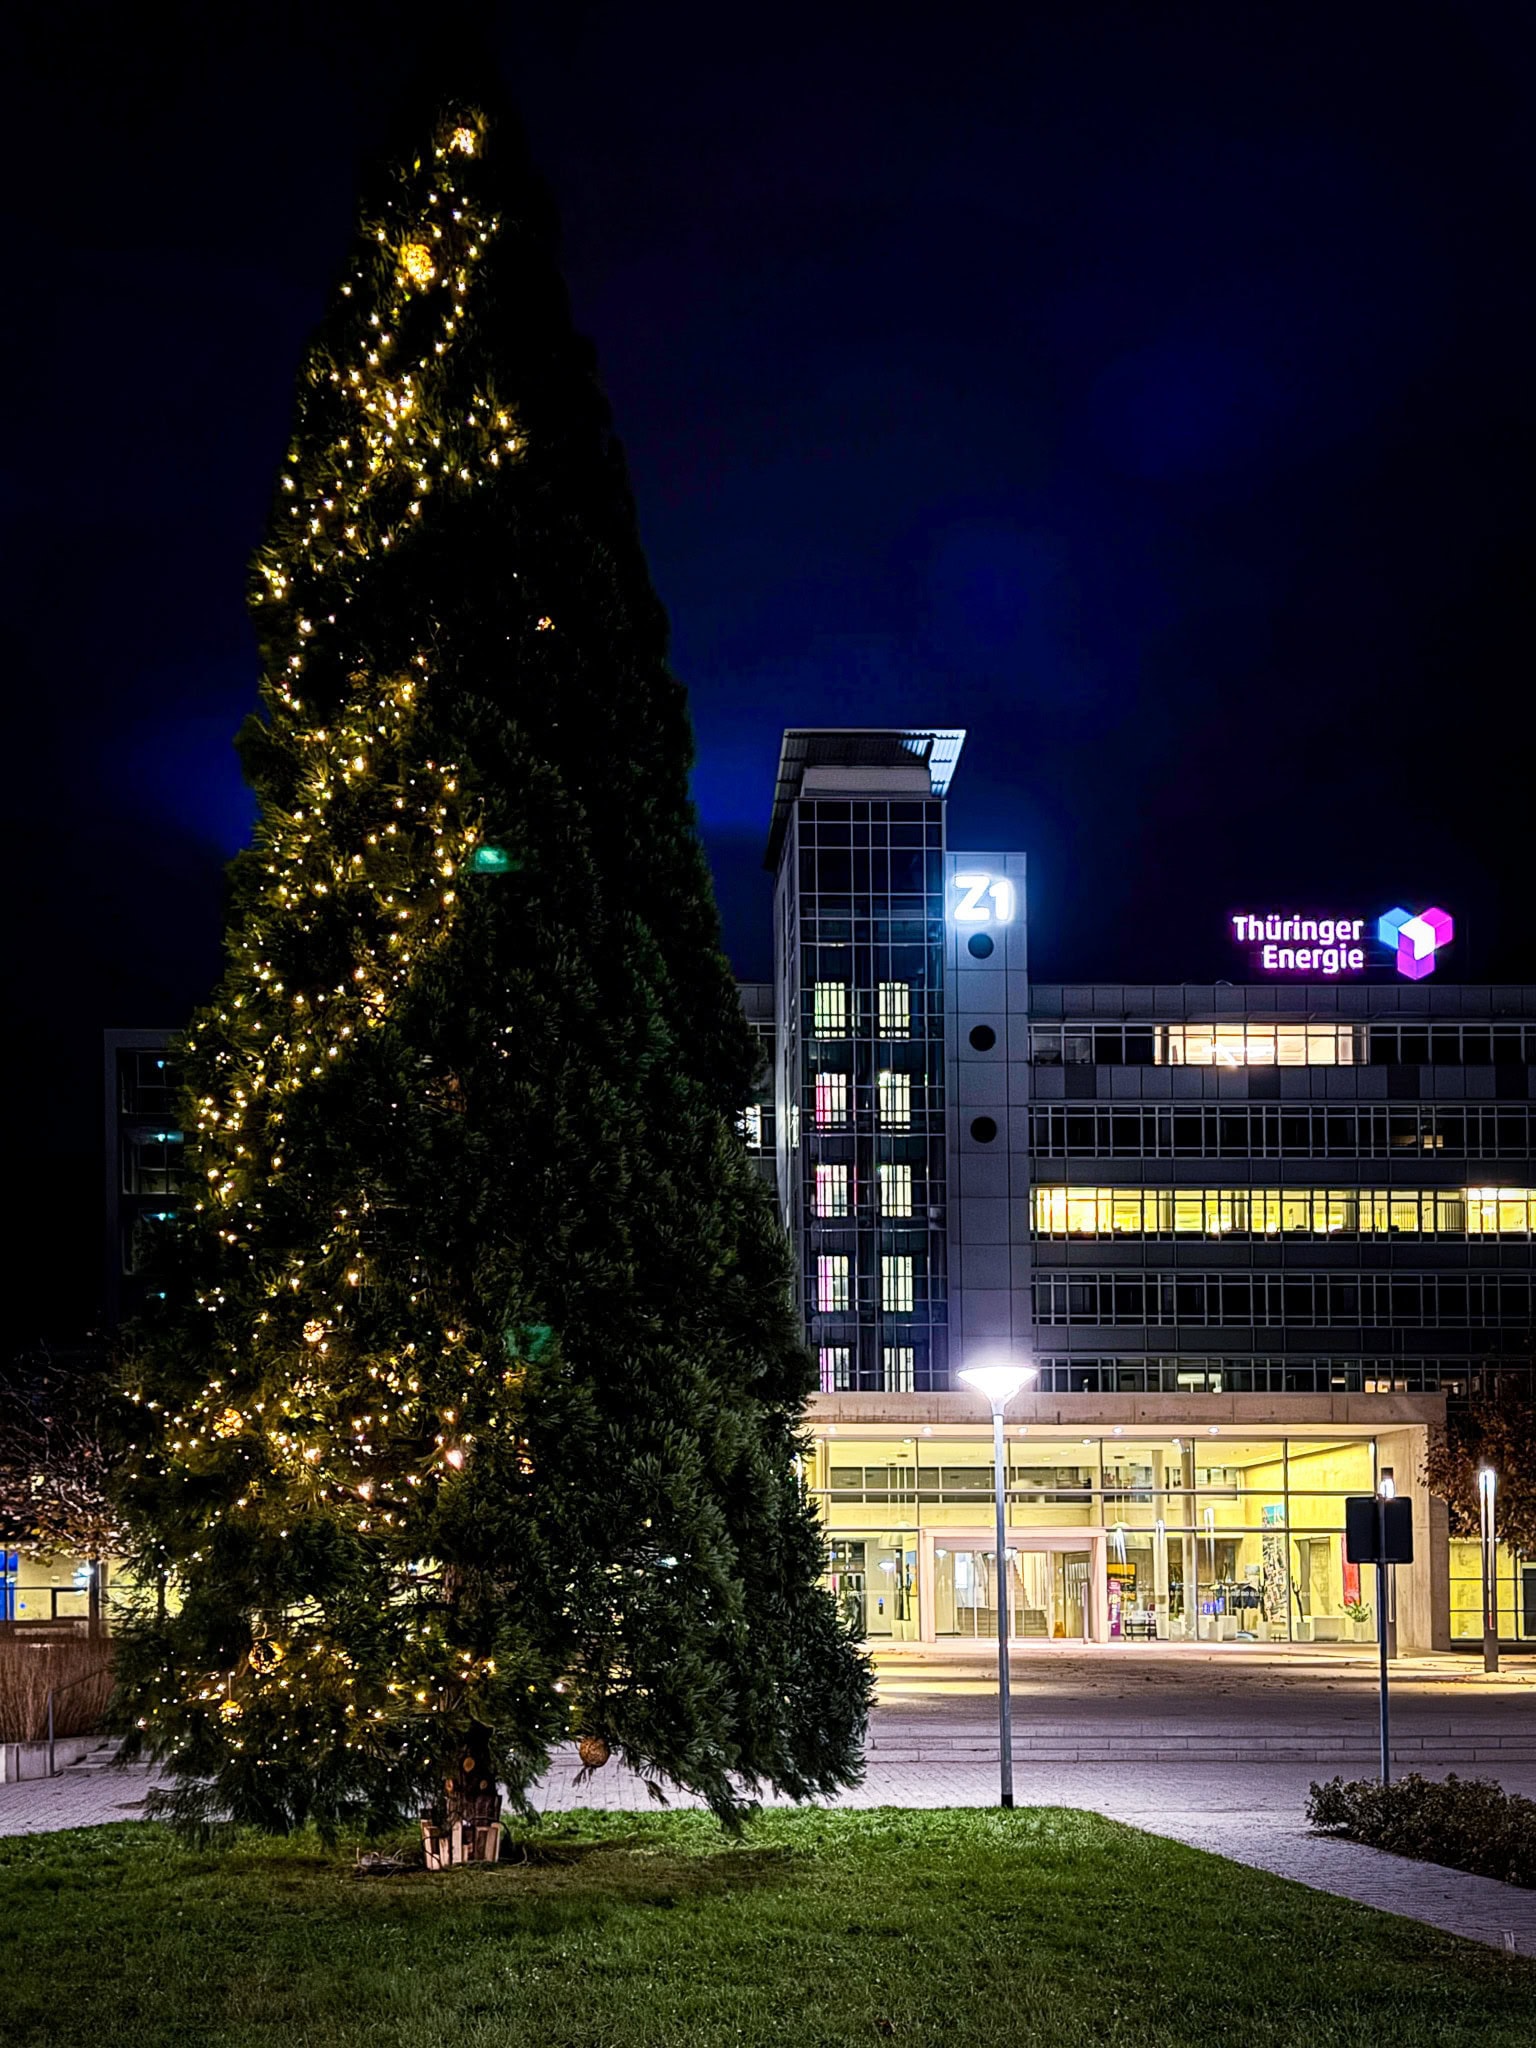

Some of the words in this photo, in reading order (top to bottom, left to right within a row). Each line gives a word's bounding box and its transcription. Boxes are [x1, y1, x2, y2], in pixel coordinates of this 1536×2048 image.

[954, 875, 1012, 921] Z1
[1232, 914, 1364, 945] Thüringer
[1263, 943, 1364, 974] Energie
